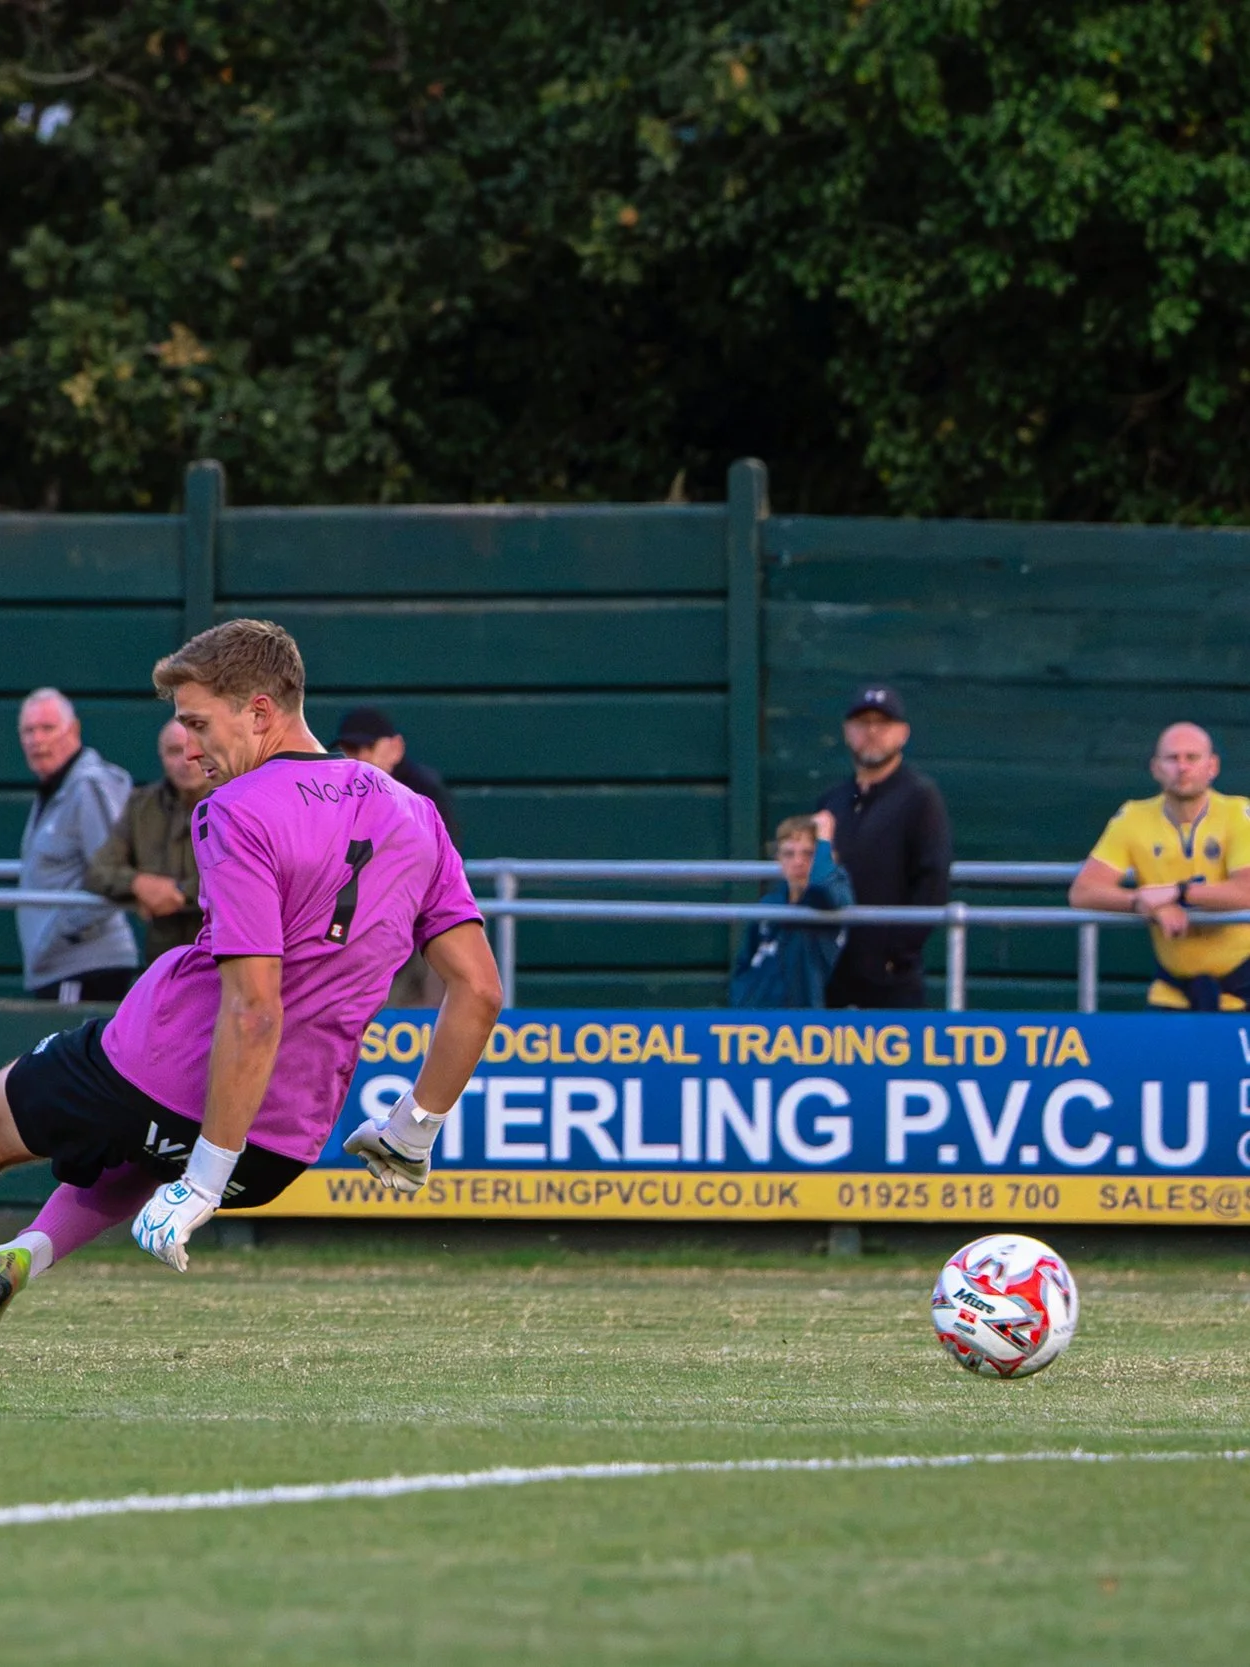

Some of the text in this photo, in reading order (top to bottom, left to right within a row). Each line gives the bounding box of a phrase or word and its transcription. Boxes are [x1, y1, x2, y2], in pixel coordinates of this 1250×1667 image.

[360, 1022, 1091, 1068] SODGLOBAL TRADING LTD T/A
[885, 1078, 1209, 1168] P.V.C.U
[838, 1182, 930, 1209] 01925
[940, 1182, 994, 1210] 818
[1007, 1184, 1061, 1211] 700
